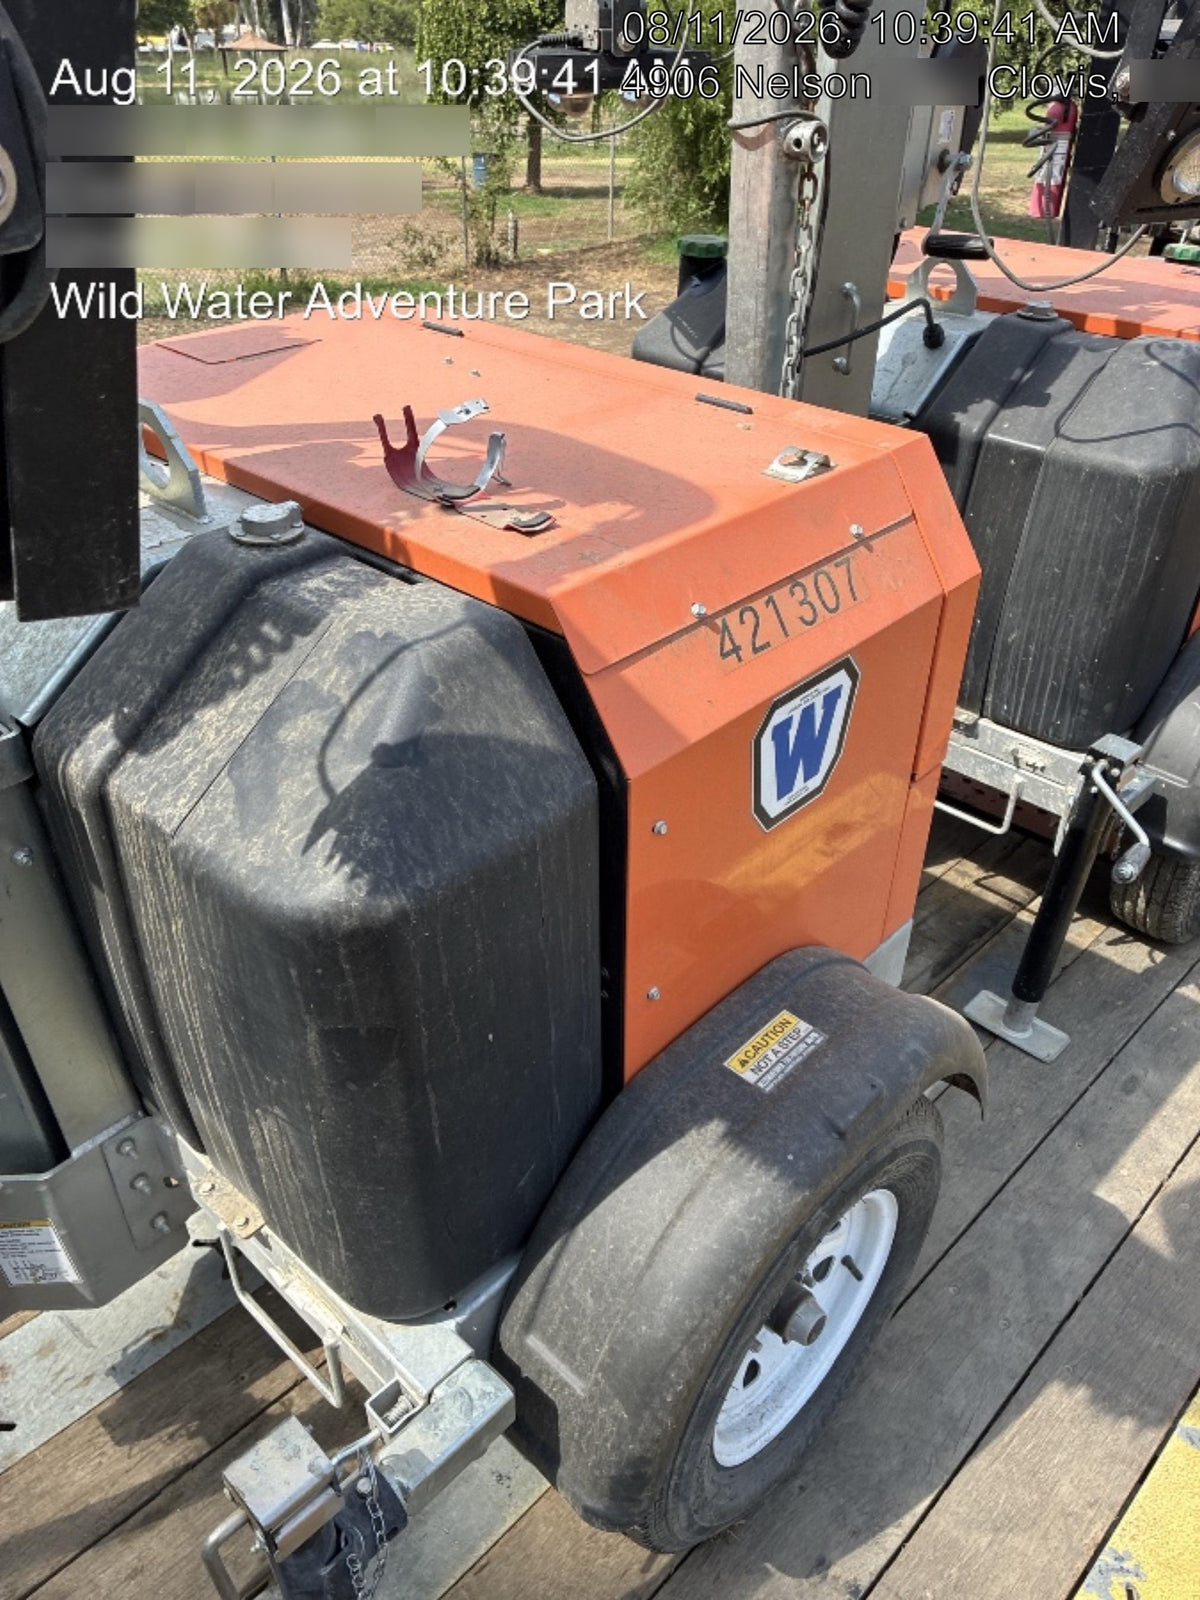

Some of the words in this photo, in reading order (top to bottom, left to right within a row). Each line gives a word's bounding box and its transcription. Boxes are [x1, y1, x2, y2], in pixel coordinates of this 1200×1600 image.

[719, 555, 858, 663] 421307
[771, 684, 843, 802] W
[744, 1018, 793, 1059] CAUTION
[750, 1053, 773, 1076] NOT
[771, 1048, 781, 1058] A
[778, 1027, 801, 1050] STEP
